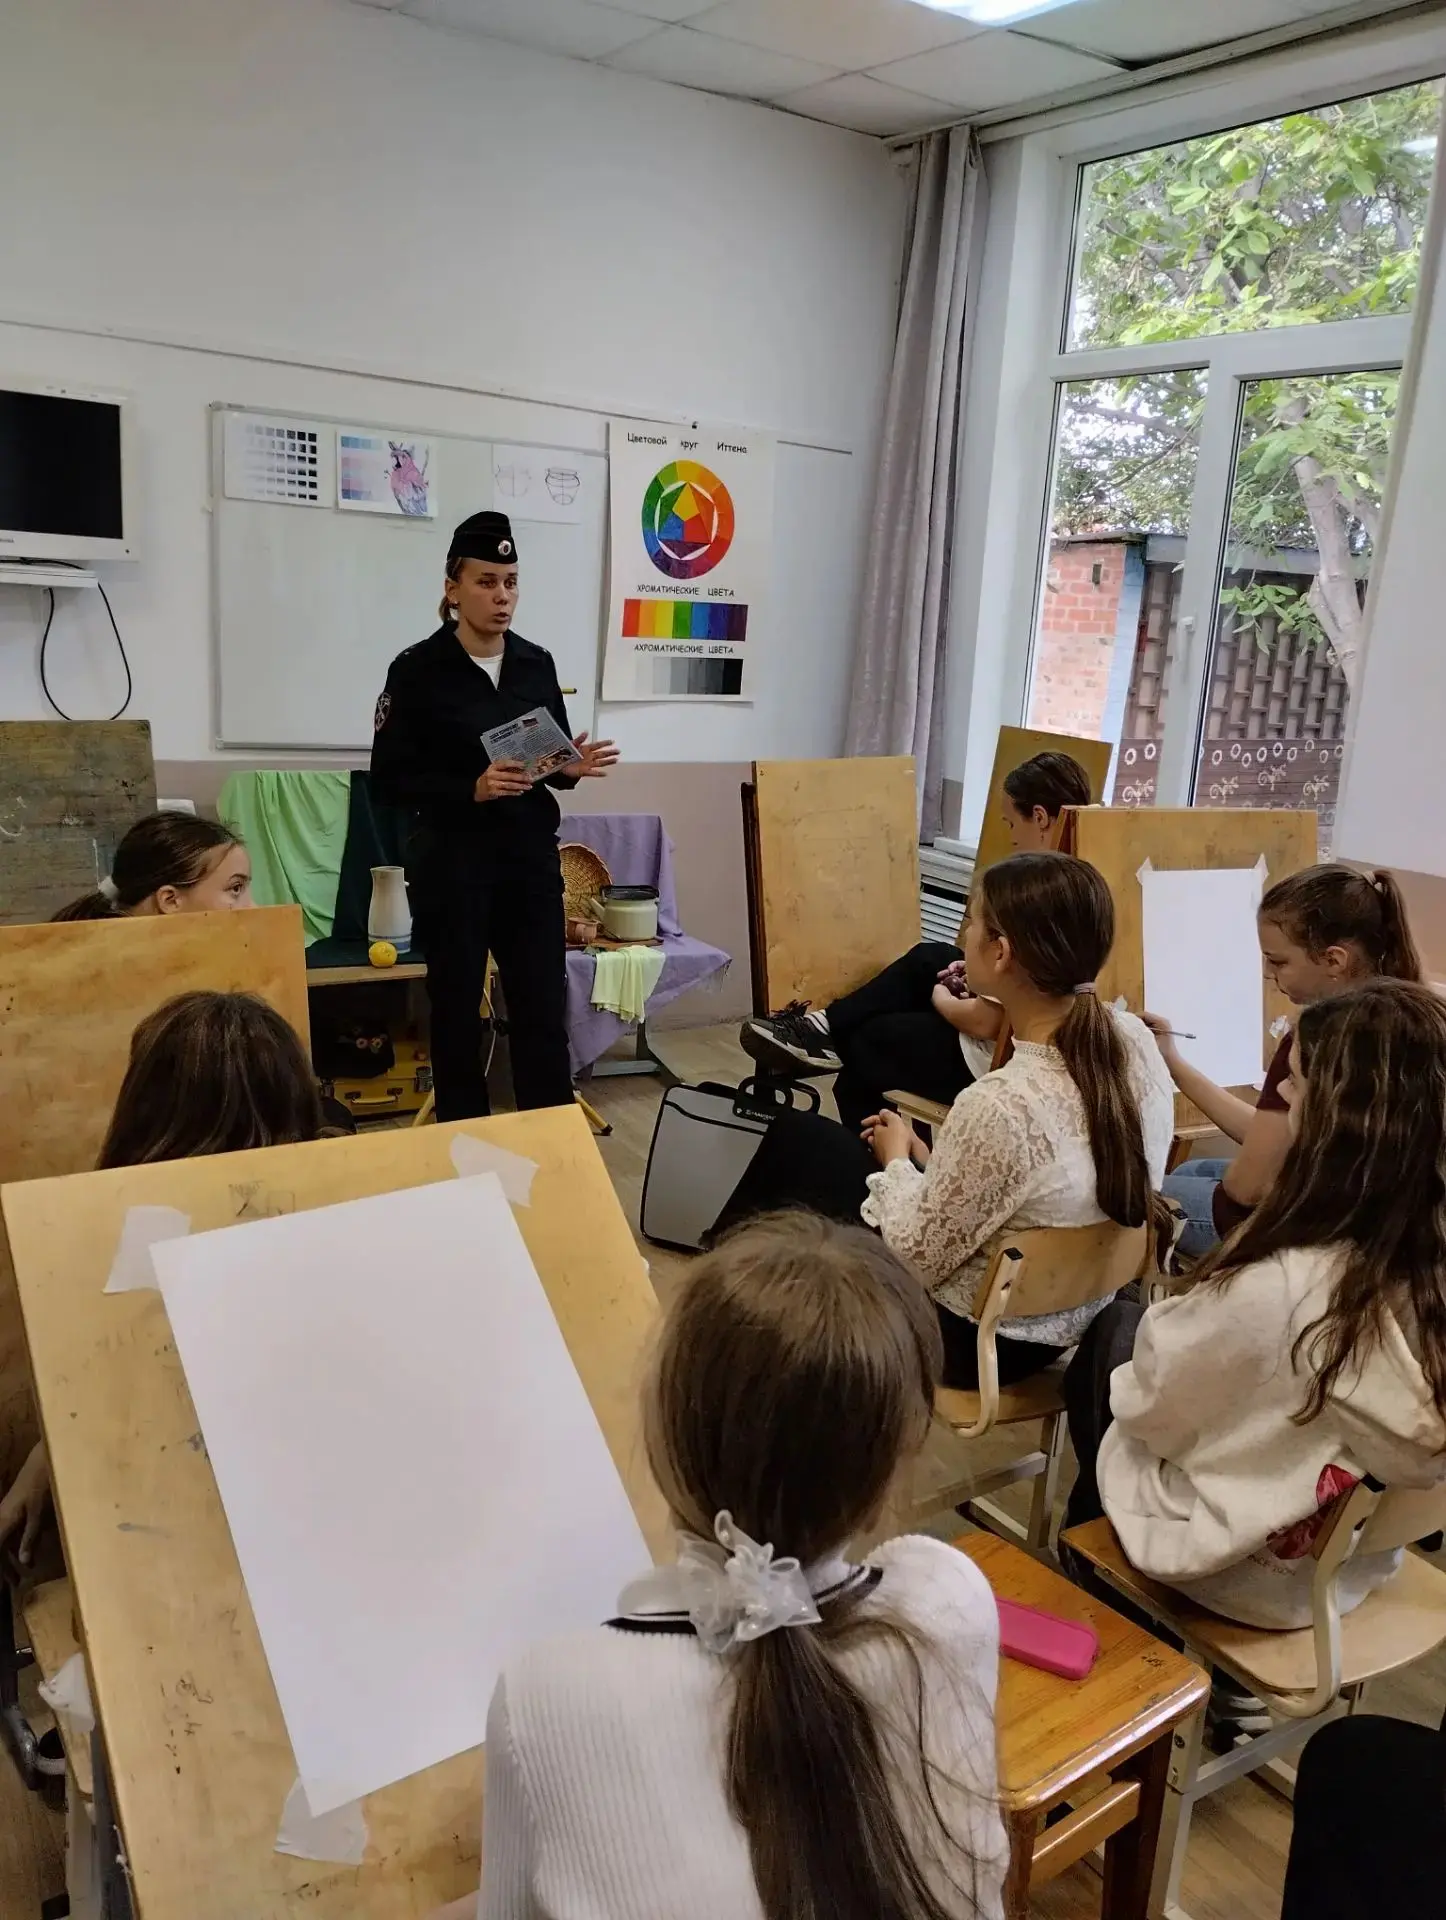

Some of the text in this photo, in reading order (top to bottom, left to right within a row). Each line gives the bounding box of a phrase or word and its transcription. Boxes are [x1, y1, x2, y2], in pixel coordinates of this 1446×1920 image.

[627, 432, 748, 454] Цветовой круг Иттена
[637, 584, 735, 597] ХРОМАТИЧЕСКИЕ ЦВЕТА
[634, 643, 735, 655] АХРОМАТИЧЕСКИЕ ЦВЕТА
